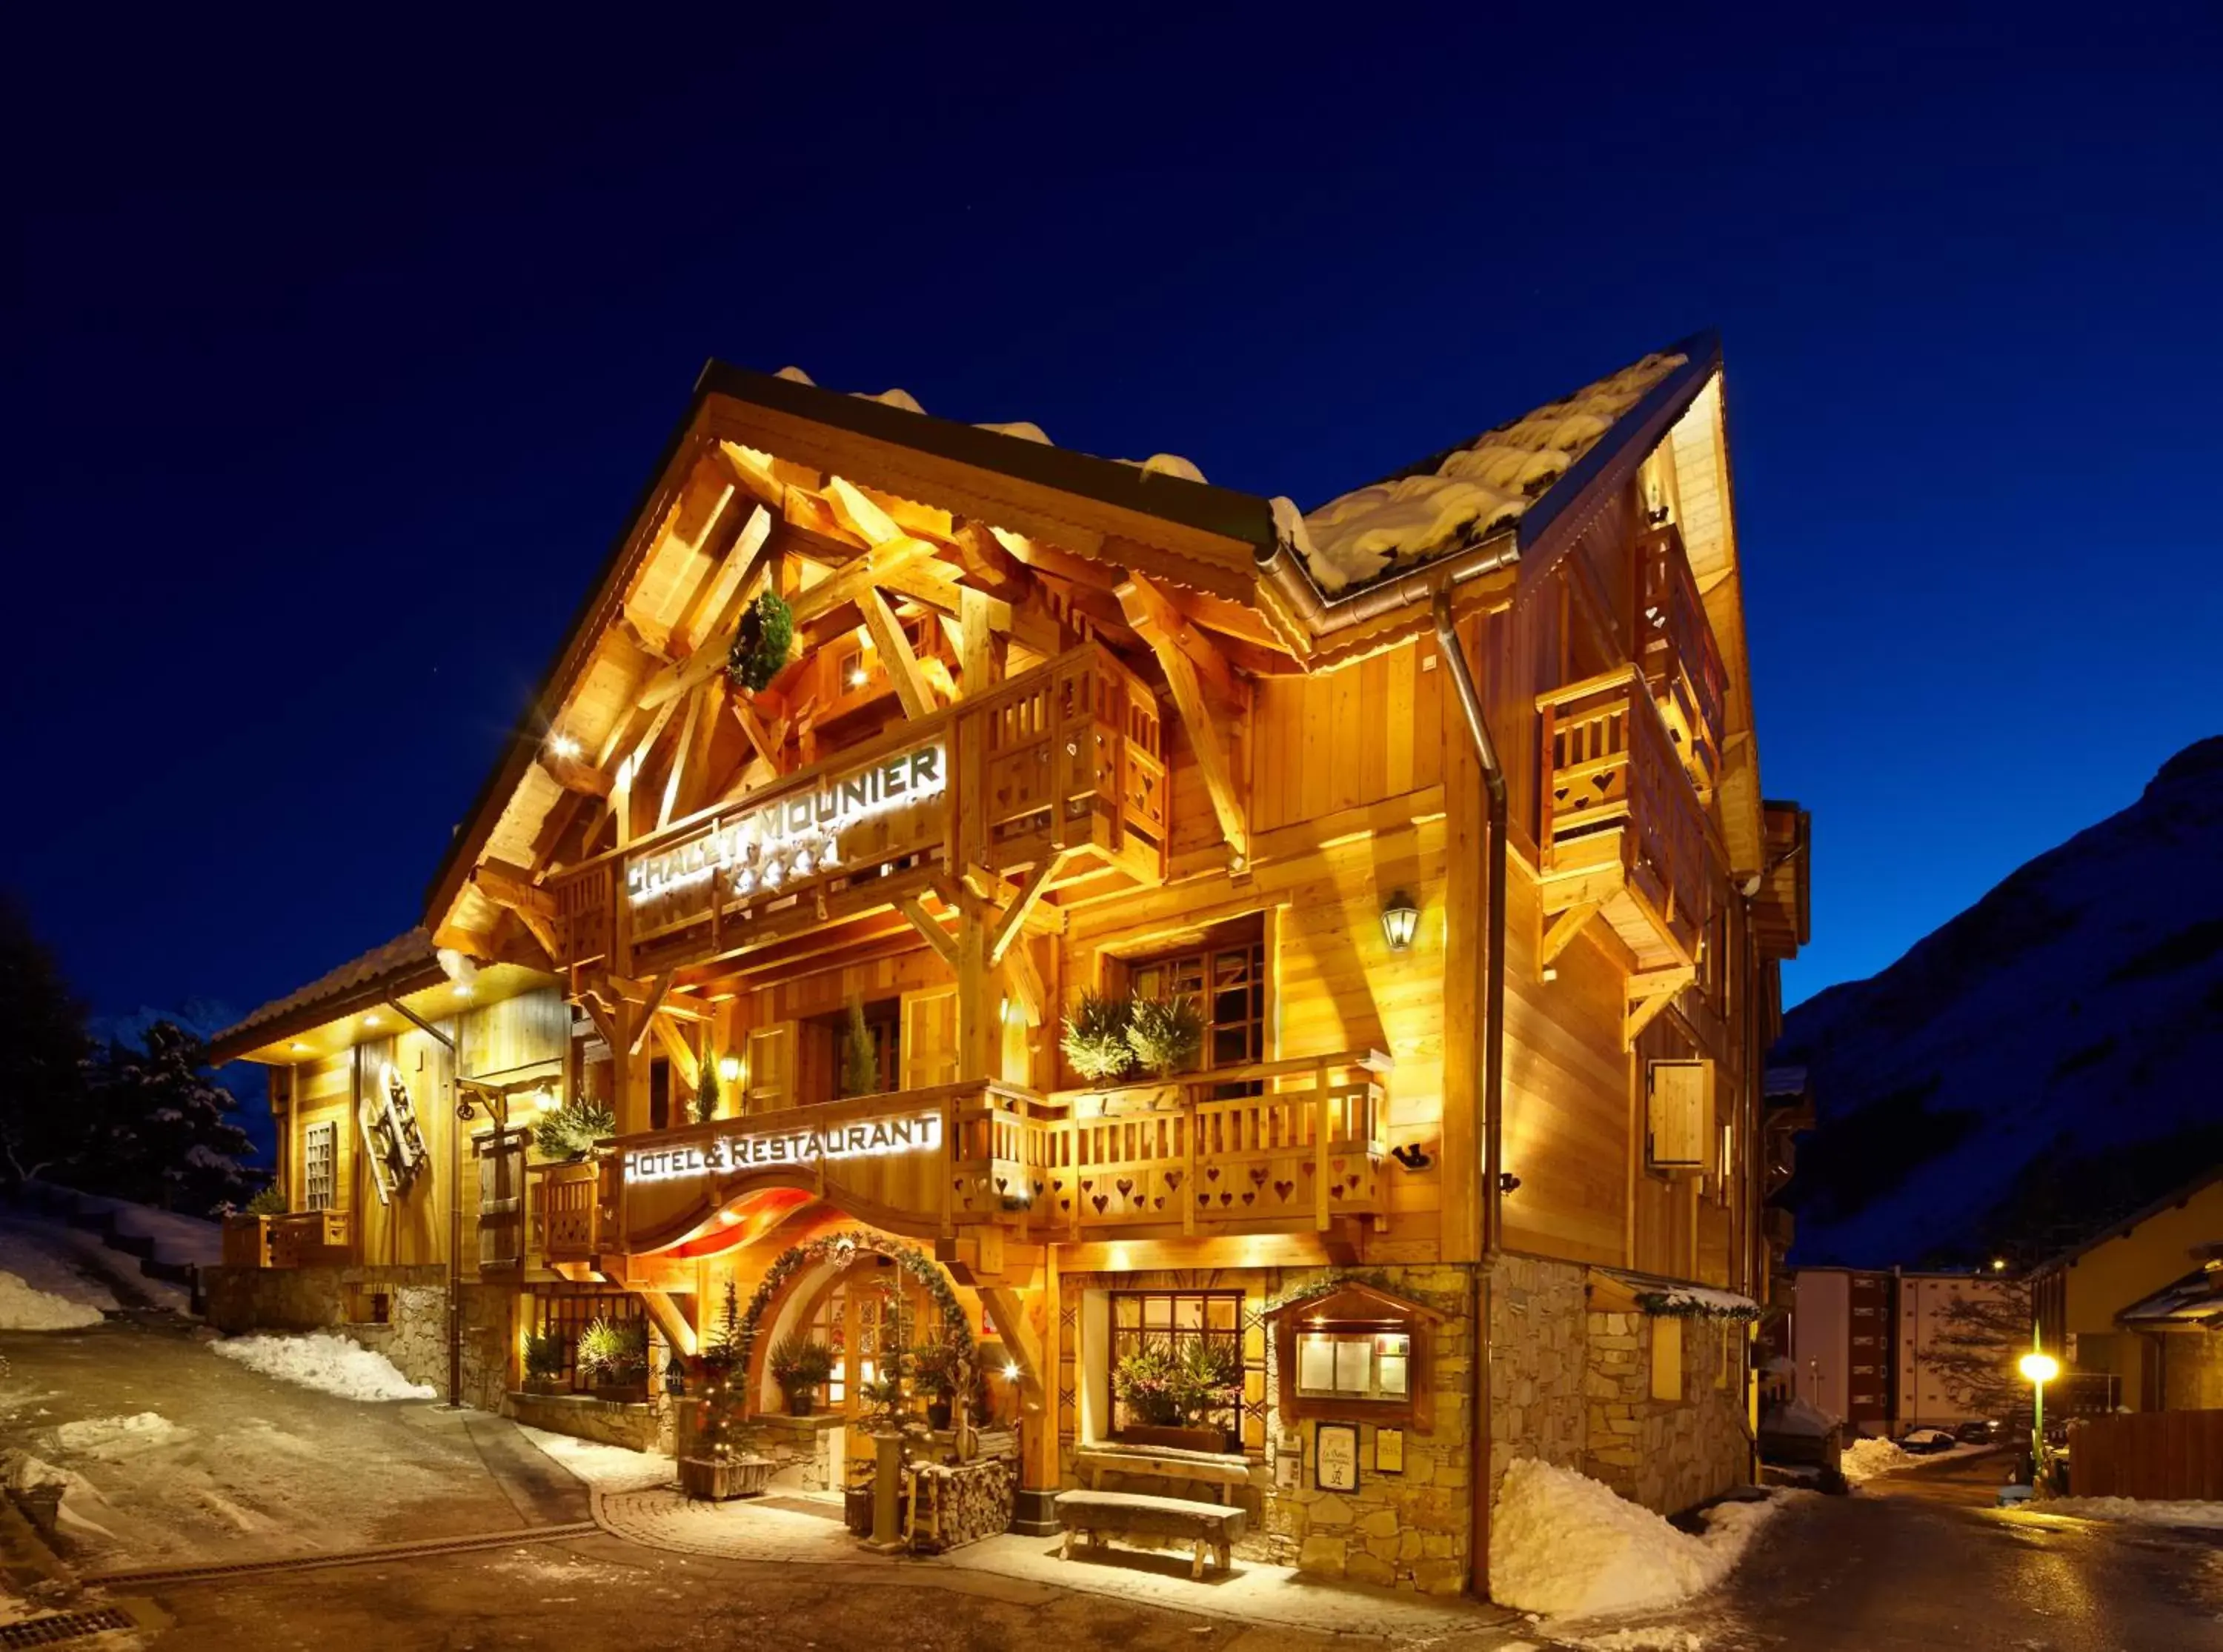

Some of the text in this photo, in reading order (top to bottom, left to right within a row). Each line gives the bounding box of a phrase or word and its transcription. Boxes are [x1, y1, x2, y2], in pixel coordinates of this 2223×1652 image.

[757, 746, 939, 839] MOUNIER
[623, 1149, 701, 1176] HOTEL
[731, 1117, 937, 1165] RESTAURANT
